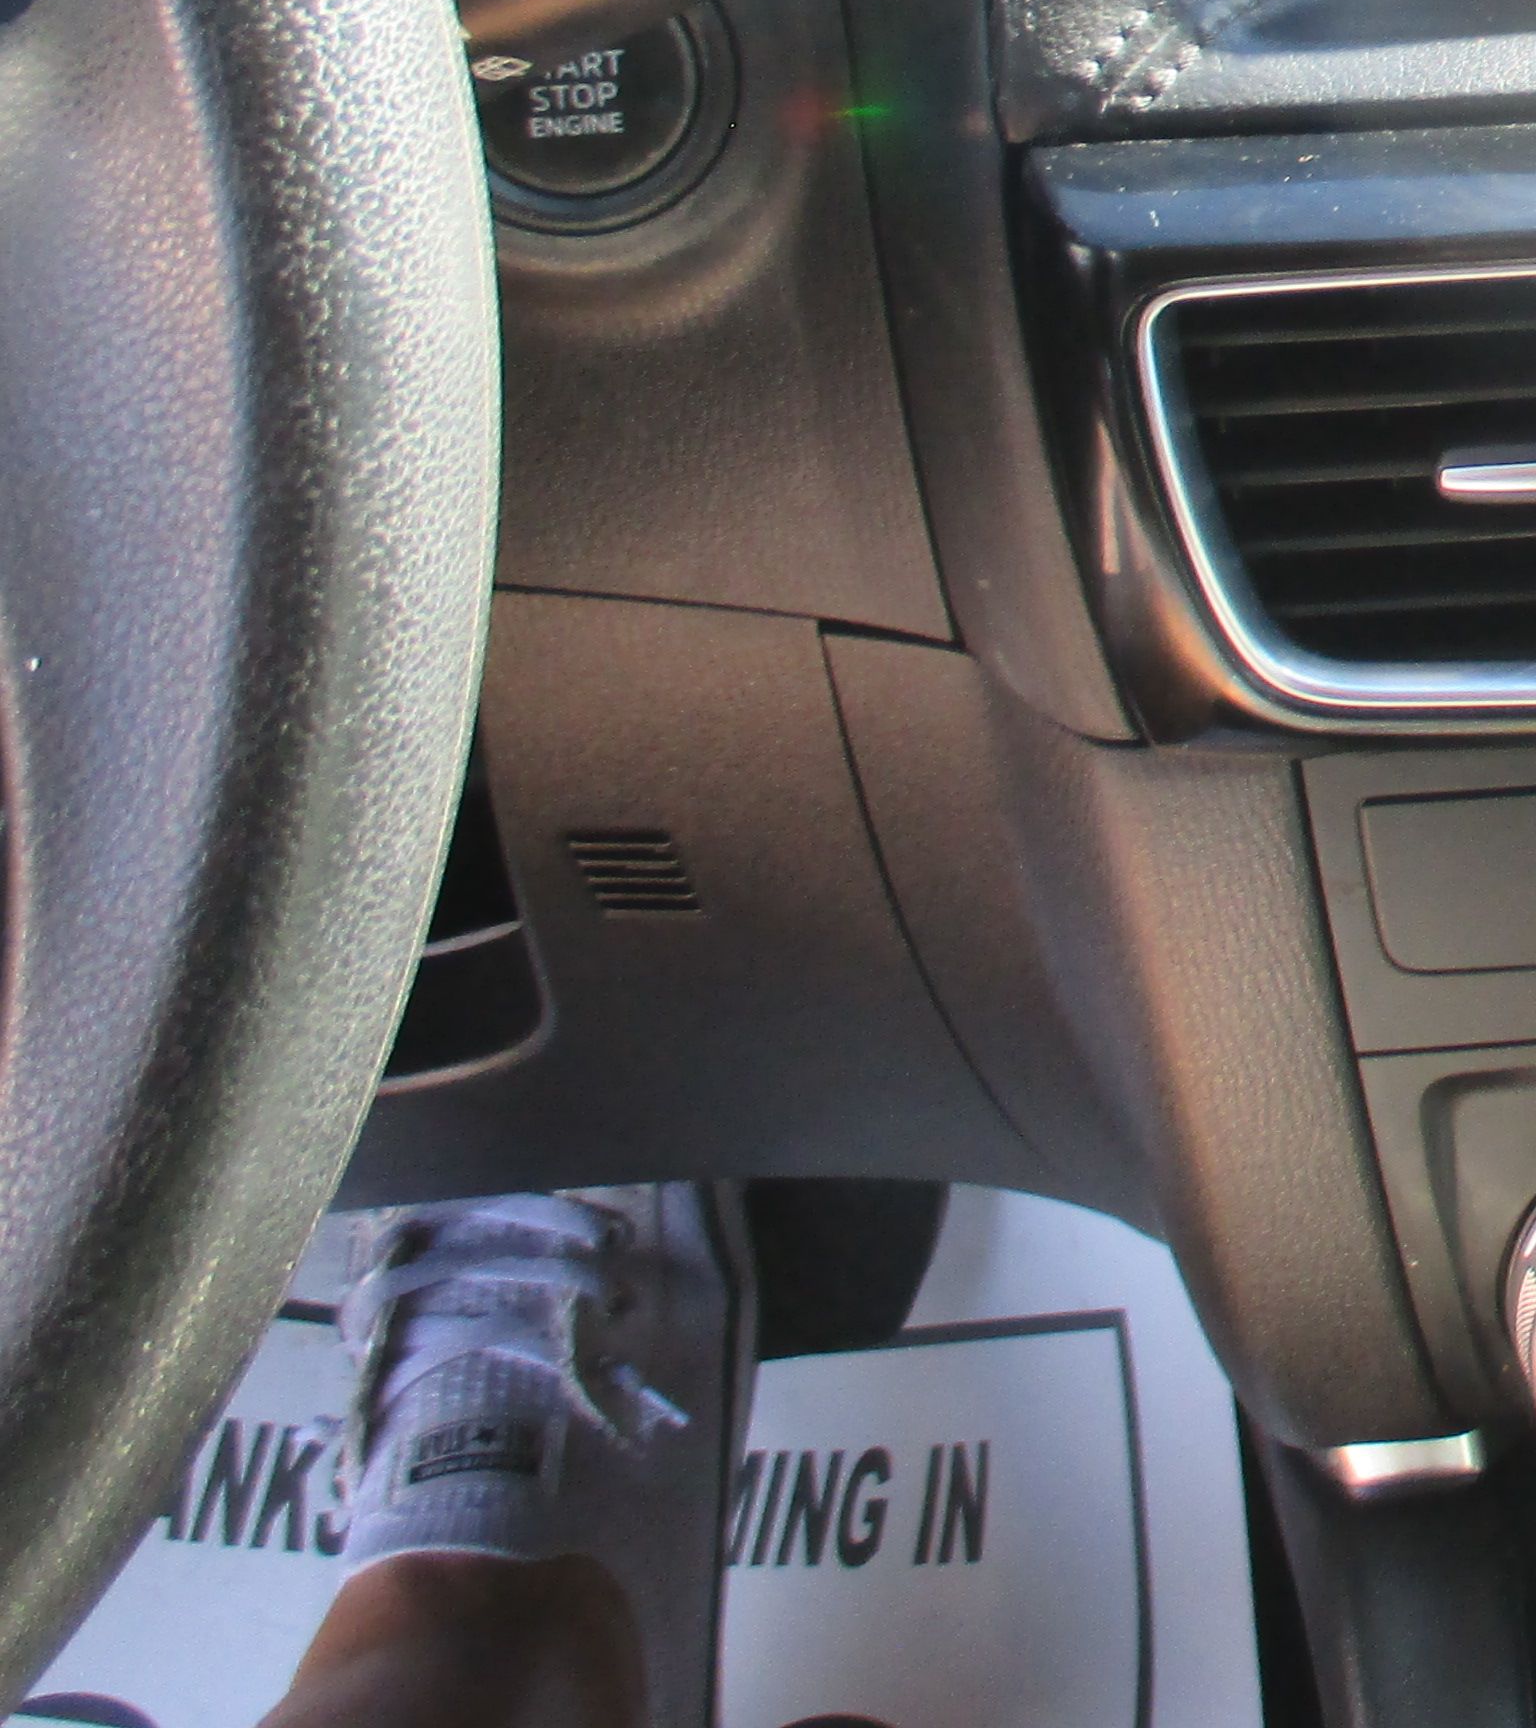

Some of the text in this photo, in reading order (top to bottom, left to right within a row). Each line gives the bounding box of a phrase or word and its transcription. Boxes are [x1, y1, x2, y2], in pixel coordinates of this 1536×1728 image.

[545, 49, 626, 80] ART
[528, 81, 619, 113] STOP
[528, 111, 626, 139] ENGINE
[912, 1439, 991, 1566] IN
